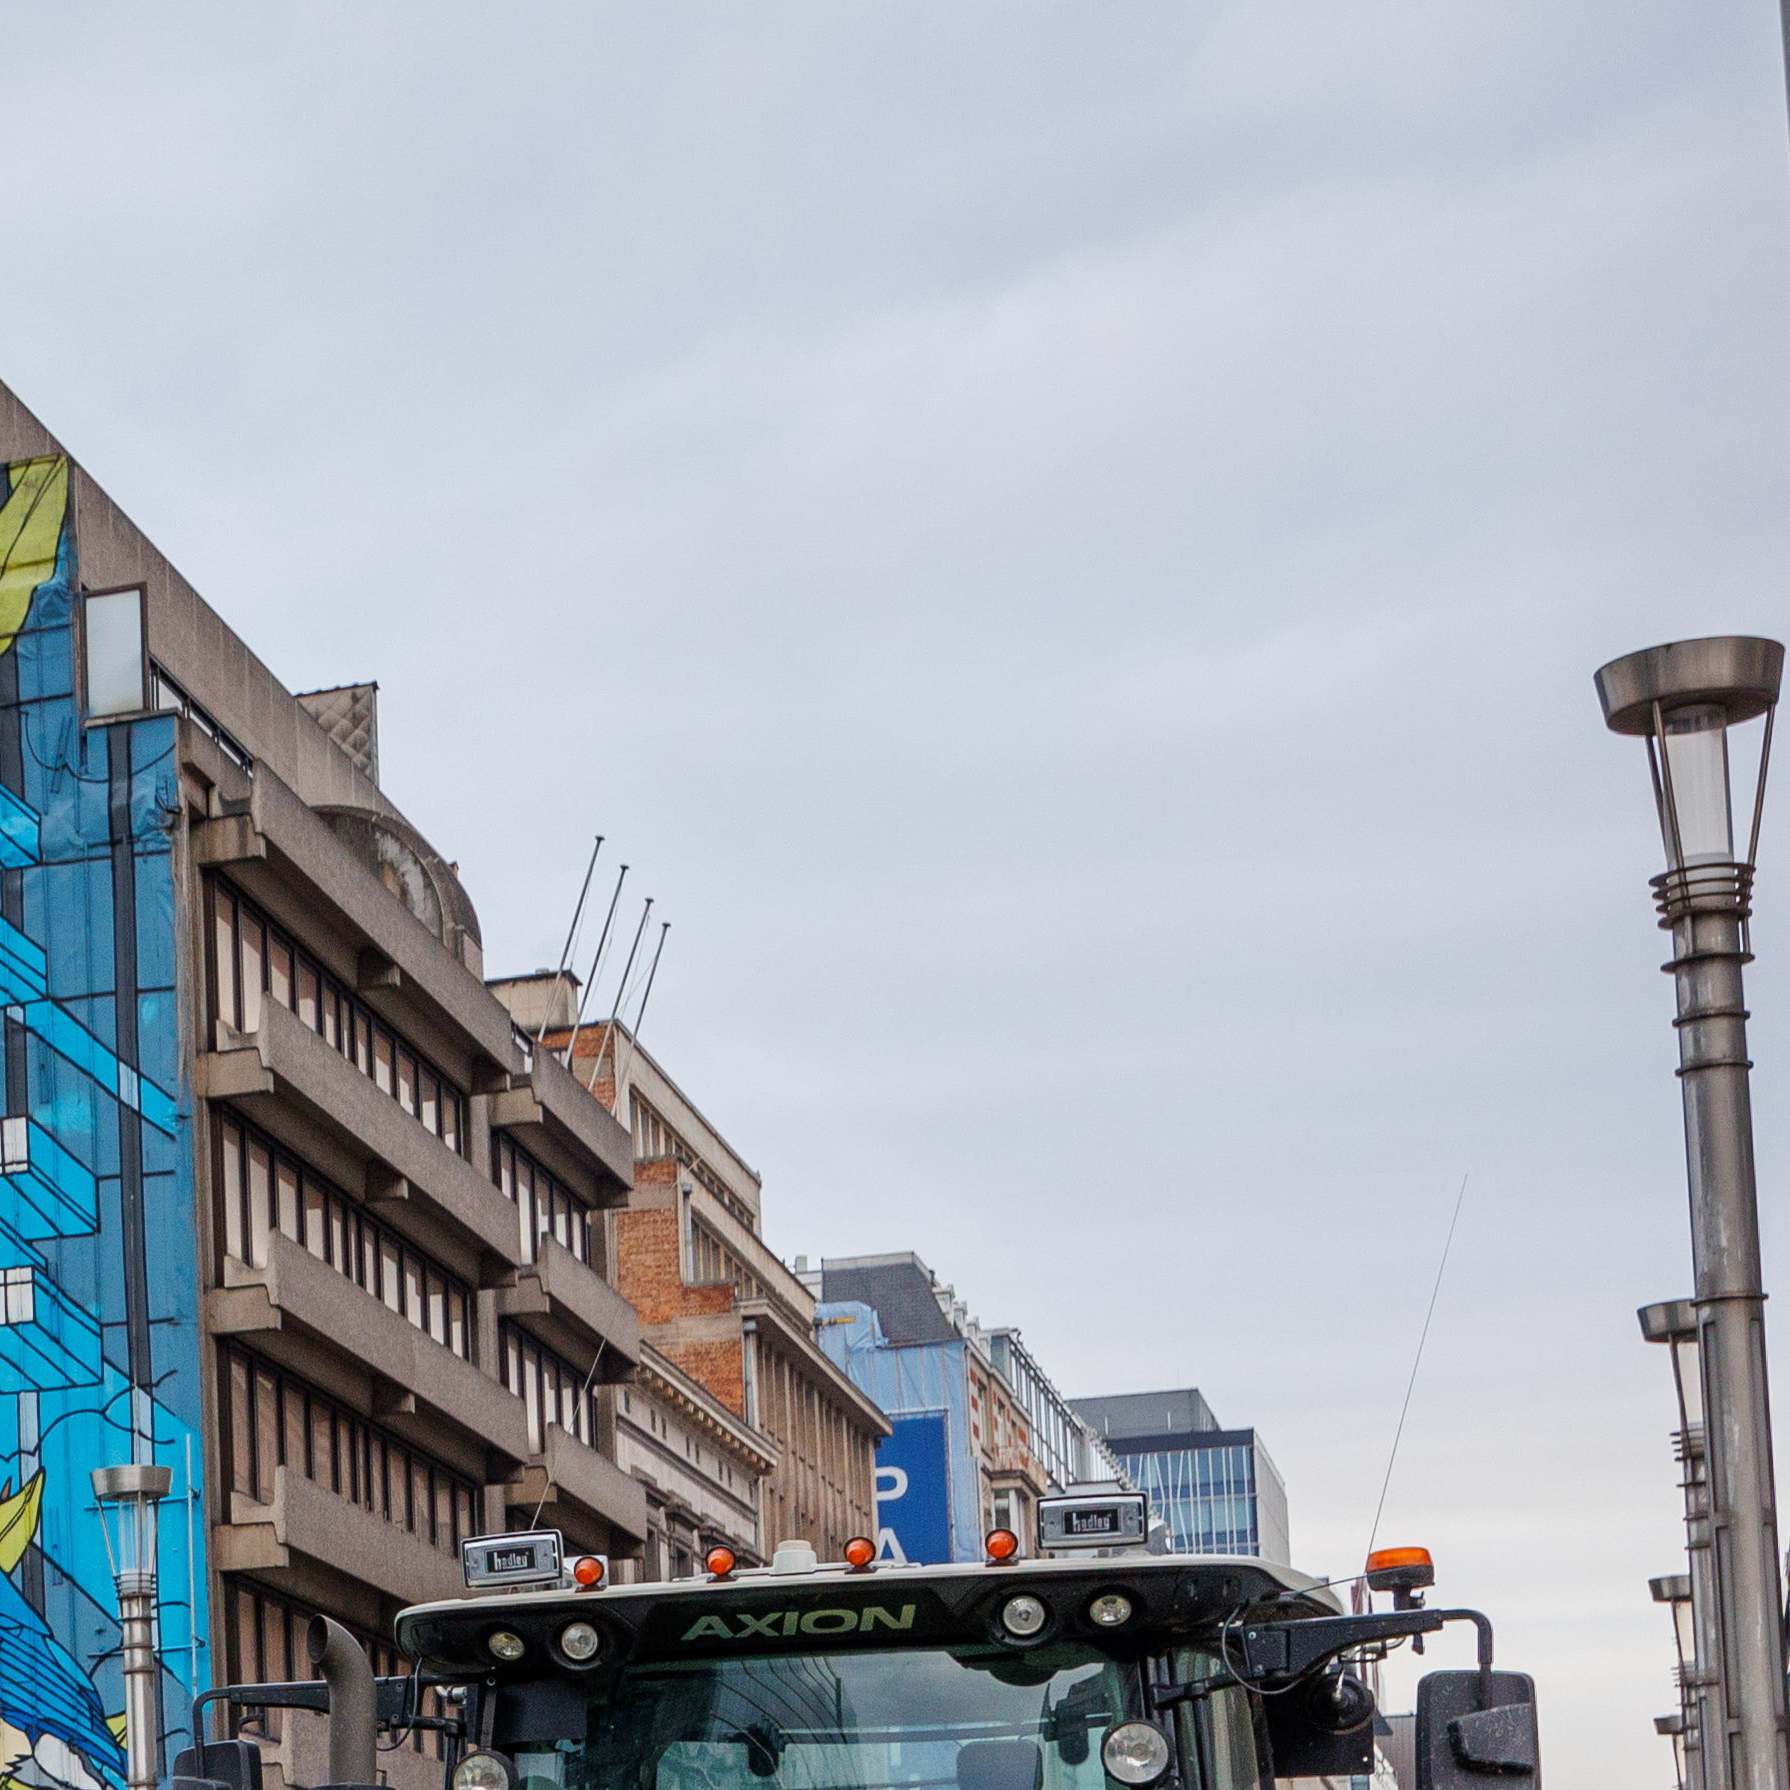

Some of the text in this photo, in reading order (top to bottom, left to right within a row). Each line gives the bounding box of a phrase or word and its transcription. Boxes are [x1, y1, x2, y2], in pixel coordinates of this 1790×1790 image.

[1072, 1511, 1111, 1532] hadley
[493, 1549, 530, 1569] hadley
[681, 1604, 916, 1640] AXION
